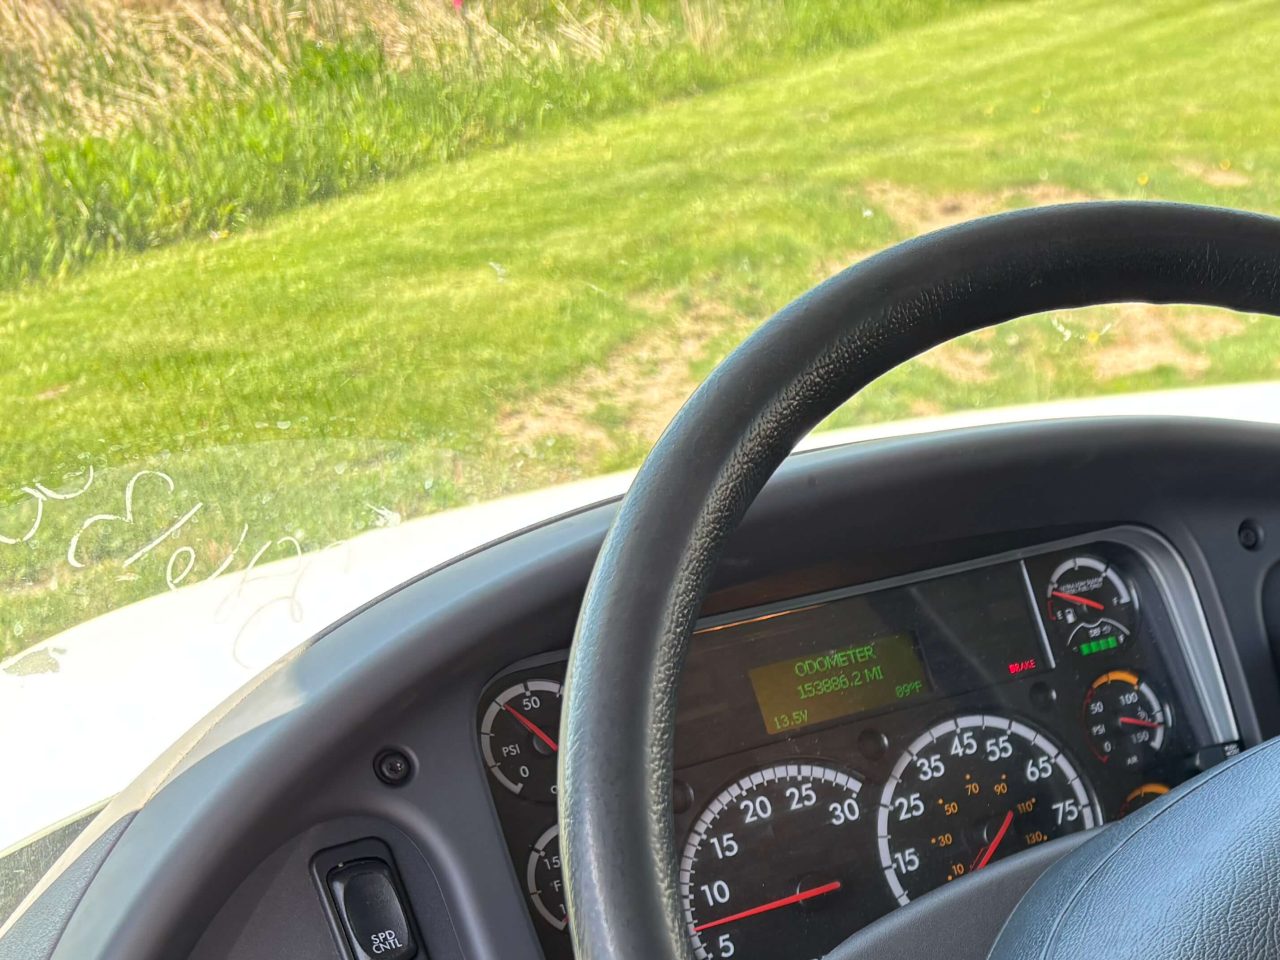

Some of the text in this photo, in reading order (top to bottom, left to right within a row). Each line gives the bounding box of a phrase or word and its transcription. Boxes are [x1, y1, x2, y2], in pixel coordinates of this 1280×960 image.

[794, 645, 874, 677] ODOMETER
[864, 665, 884, 683] MI
[523, 697, 540, 711] 50
[1119, 691, 1139, 706] 100
[1090, 700, 1104, 715] 50
[950, 731, 978, 758] 45
[1130, 730, 1150, 746] 150
[502, 744, 521, 757] PSI
[985, 735, 1013, 762] 55
[1104, 741, 1112, 753] 0
[520, 765, 530, 778] 0
[916, 754, 945, 781] 35
[1026, 756, 1053, 782] 65
[785, 783, 817, 811] 25
[965, 782, 980, 796] 70
[994, 782, 1008, 796] 90
[739, 795, 772, 824] 20
[828, 798, 860, 826] 30
[894, 793, 925, 821] 25
[944, 802, 959, 816] 50
[1017, 801, 1033, 814] 110
[1051, 799, 1079, 825] 75
[710, 832, 739, 860] 15
[937, 832, 953, 847] 30
[1025, 831, 1043, 846] 130
[894, 847, 920, 875] 15
[952, 863, 965, 876] 10
[700, 880, 730, 907] 10
[371, 930, 395, 944] SPD
[372, 938, 402, 953] CNTL
[718, 933, 735, 958] 5
